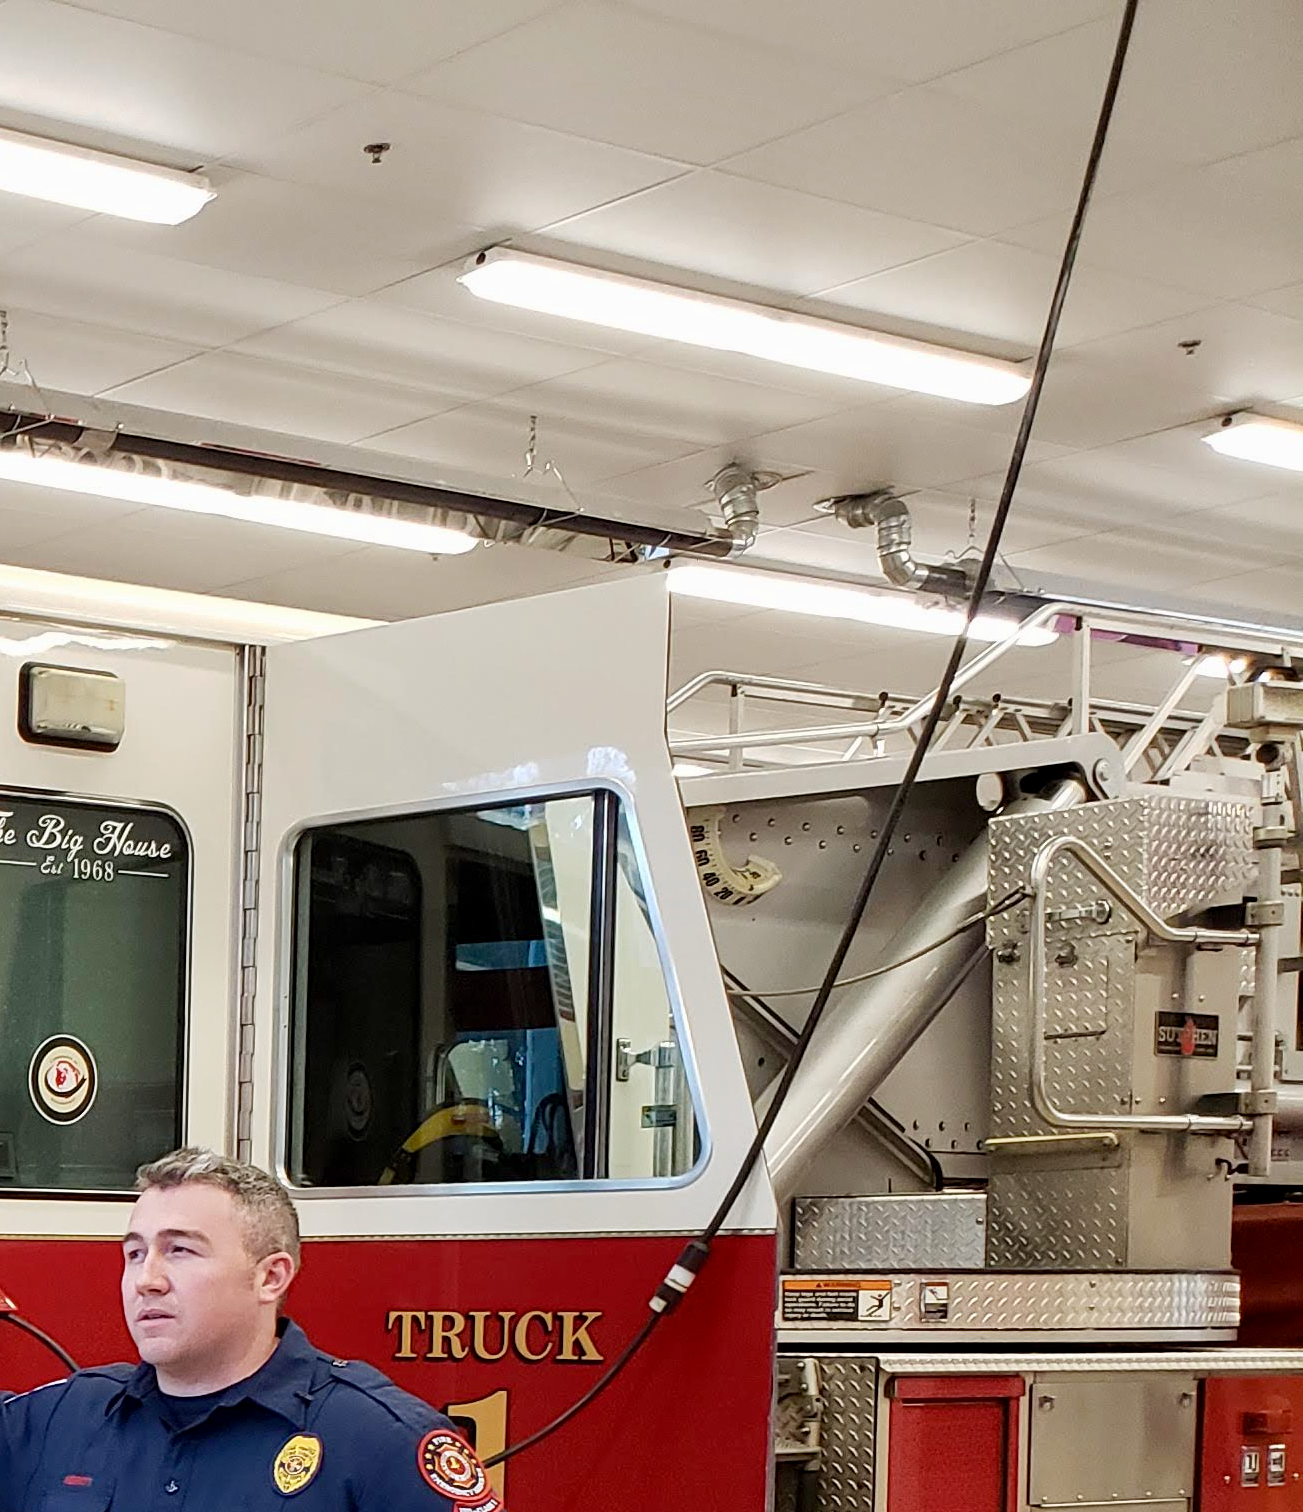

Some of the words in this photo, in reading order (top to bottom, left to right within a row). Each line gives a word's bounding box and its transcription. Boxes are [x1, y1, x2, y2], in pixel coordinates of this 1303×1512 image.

[26, 814, 84, 862] Big
[93, 820, 172, 859] House
[690, 825, 705, 842] 80
[694, 849, 710, 867] 60
[72, 857, 115, 882] 1968
[702, 872, 720, 887] 40
[713, 886, 734, 900] 20
[387, 1310, 604, 1362] TRUCK
[447, 1390, 509, 1510] 1
